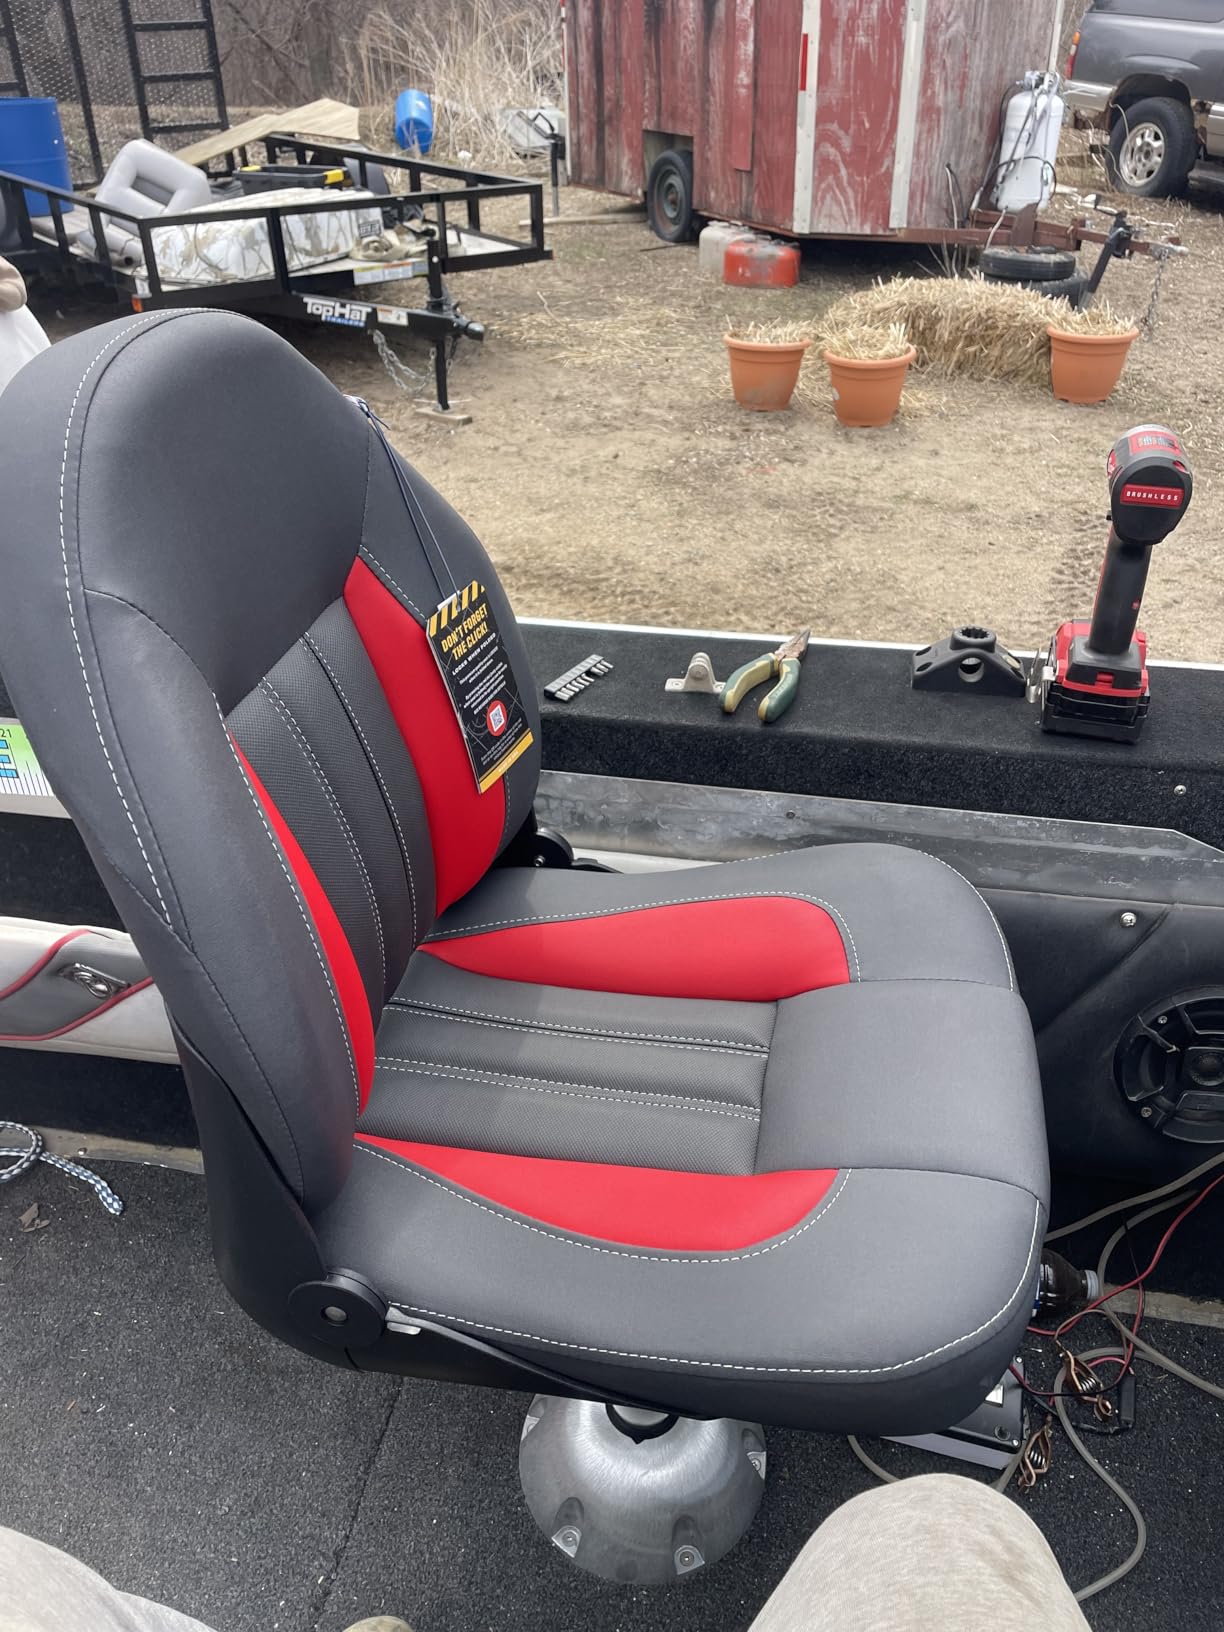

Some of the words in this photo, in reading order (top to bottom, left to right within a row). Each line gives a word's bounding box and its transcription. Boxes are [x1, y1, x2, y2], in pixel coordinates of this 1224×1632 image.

[1126, 490, 1178, 501] BRUSHLESS
[441, 625, 464, 653] DON'T
[463, 603, 487, 633] FORGET
[452, 641, 467, 660] THE
[466, 621, 488, 648] CLICK!
[452, 660, 468, 675] LOCKS
[468, 648, 481, 661] WHEN
